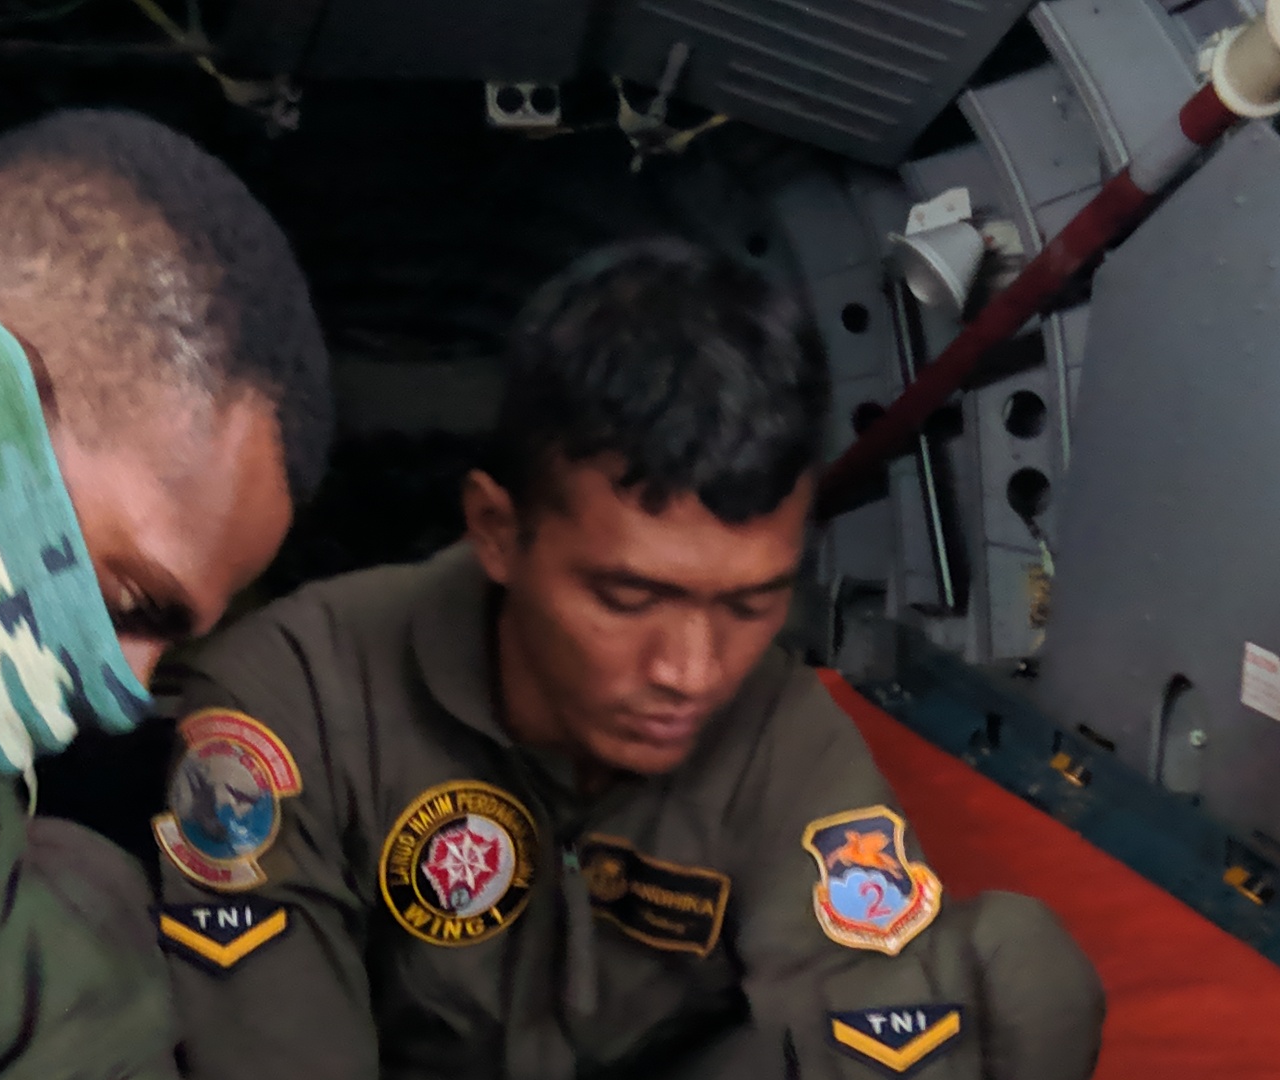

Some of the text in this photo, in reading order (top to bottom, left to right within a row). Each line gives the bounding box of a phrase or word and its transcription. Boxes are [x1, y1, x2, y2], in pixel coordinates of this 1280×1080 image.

[408, 794, 453, 836] HALIM
[192, 905, 253, 930] TNI
[860, 880, 893, 920] 2
[404, 903, 486, 940] WING
[867, 1010, 927, 1035] TNI
